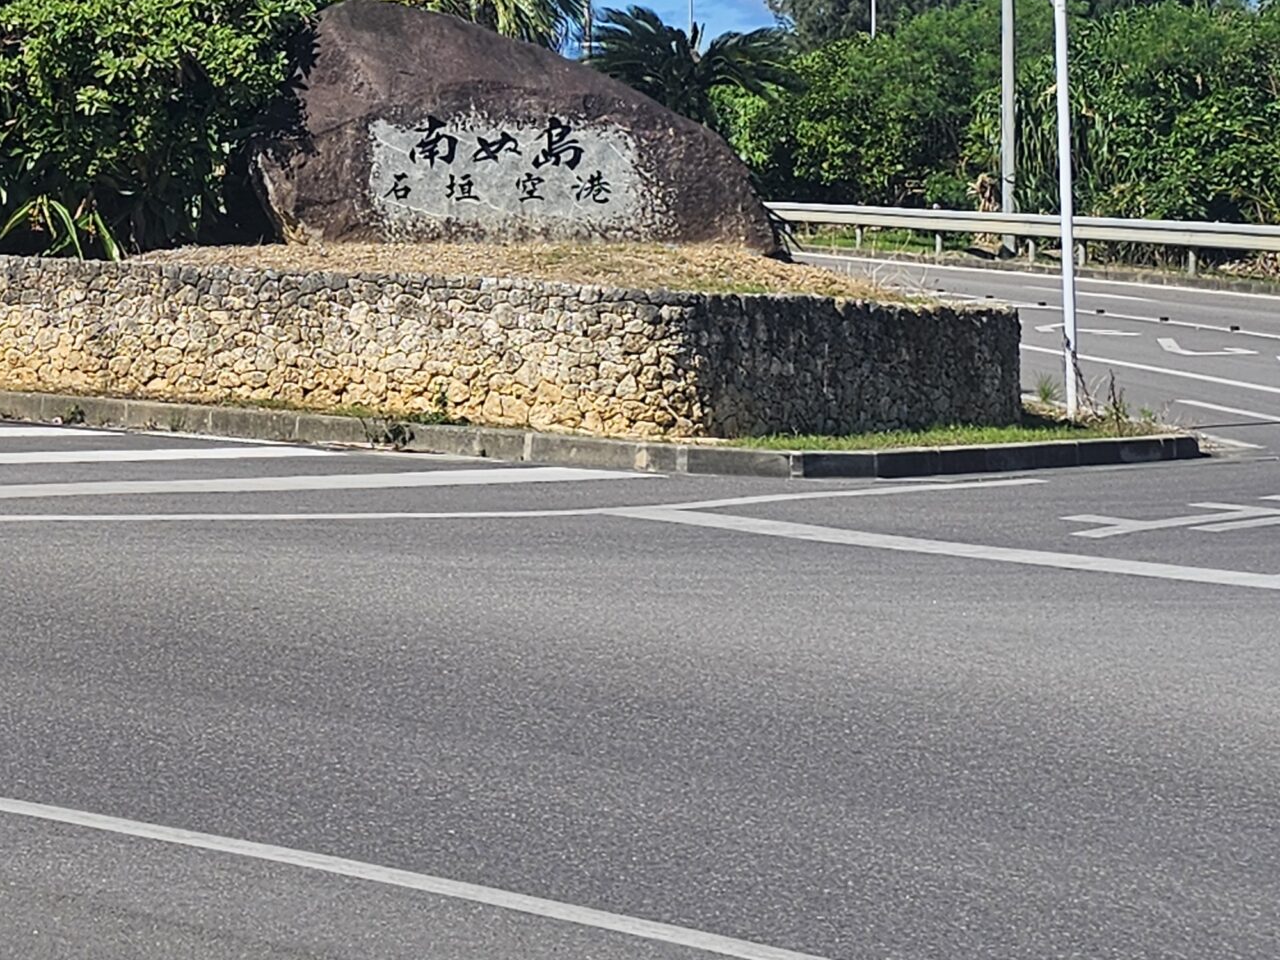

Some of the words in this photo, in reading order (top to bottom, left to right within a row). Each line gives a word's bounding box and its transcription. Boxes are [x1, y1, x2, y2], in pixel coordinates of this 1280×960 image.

[409, 115, 585, 170] 南ぬ島
[384, 171, 612, 204] 石垣空港
